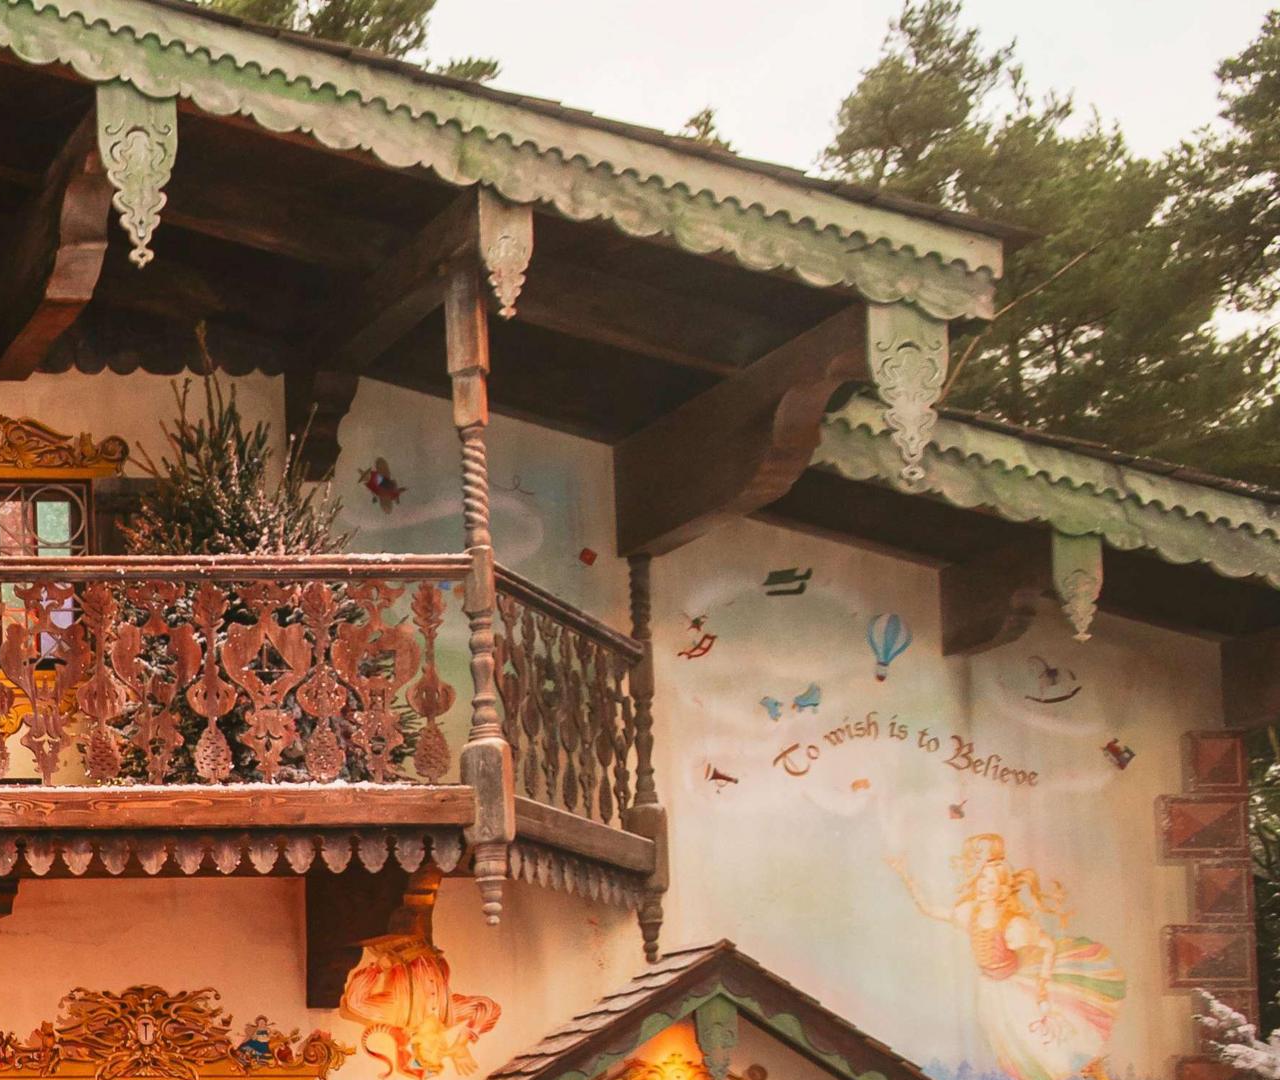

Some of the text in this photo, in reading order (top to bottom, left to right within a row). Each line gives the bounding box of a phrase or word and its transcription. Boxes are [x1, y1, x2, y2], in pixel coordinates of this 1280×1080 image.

[773, 711, 1039, 787] To wish is to Believe
